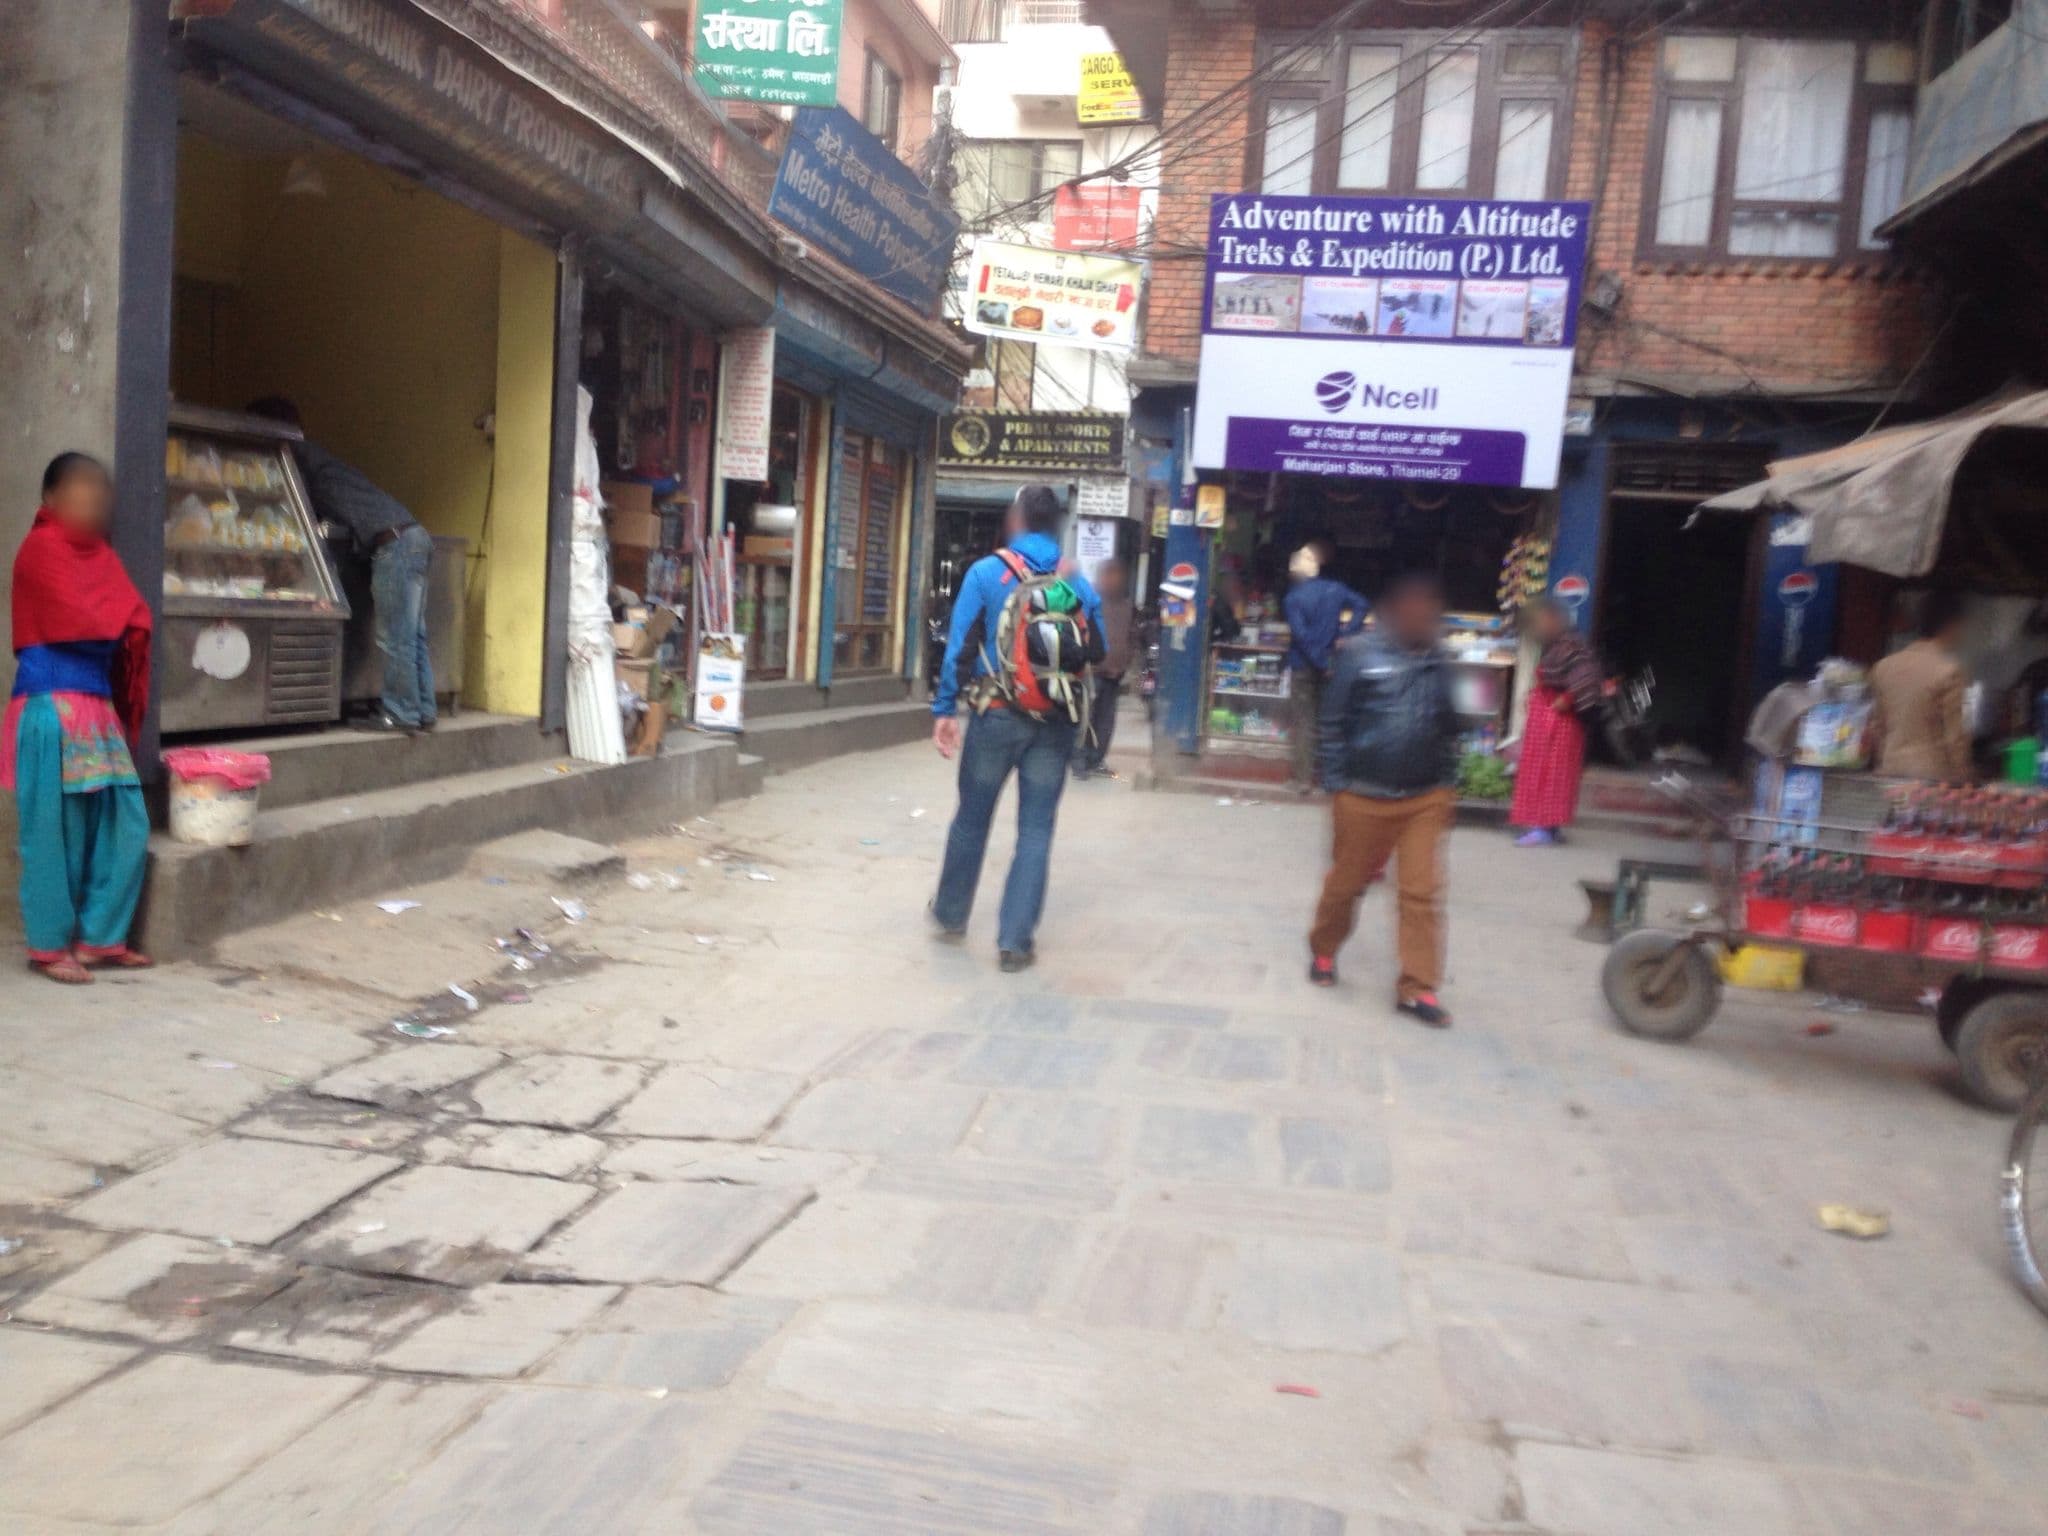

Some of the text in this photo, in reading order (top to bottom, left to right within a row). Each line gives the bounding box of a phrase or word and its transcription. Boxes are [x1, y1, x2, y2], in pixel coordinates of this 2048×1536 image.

[702, 8, 832, 57] संस्था लि.
[433, 45, 502, 124] DAIRY
[1082, 56, 1113, 75] CARGO
[784, 149, 831, 209] Metro
[831, 184, 877, 243] Health
[1219, 201, 1578, 239] Adventure with Altitude
[1219, 235, 1565, 279] Treks & Expedition (P.) Ltd.
[1362, 384, 1439, 410] Ncell
[1054, 423, 1113, 438] SPORTS
[1283, 458, 1345, 476] Maharjan
